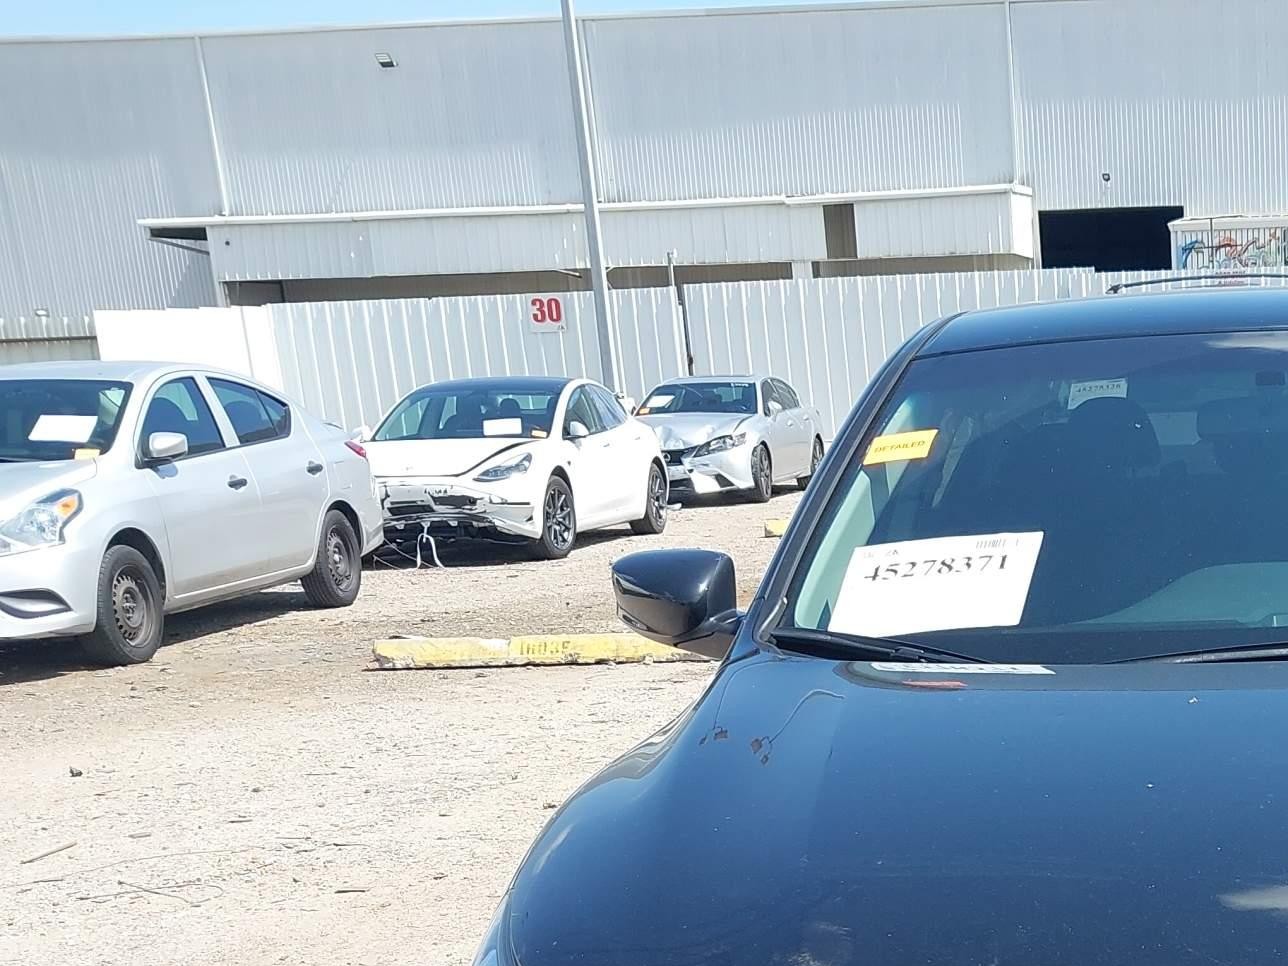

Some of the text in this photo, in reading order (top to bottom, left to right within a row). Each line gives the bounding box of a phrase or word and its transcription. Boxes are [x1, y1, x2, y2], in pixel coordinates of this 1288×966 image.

[531, 298, 561, 323] 30
[873, 440, 925, 454] DETAILED
[864, 554, 1008, 582] 45278371
